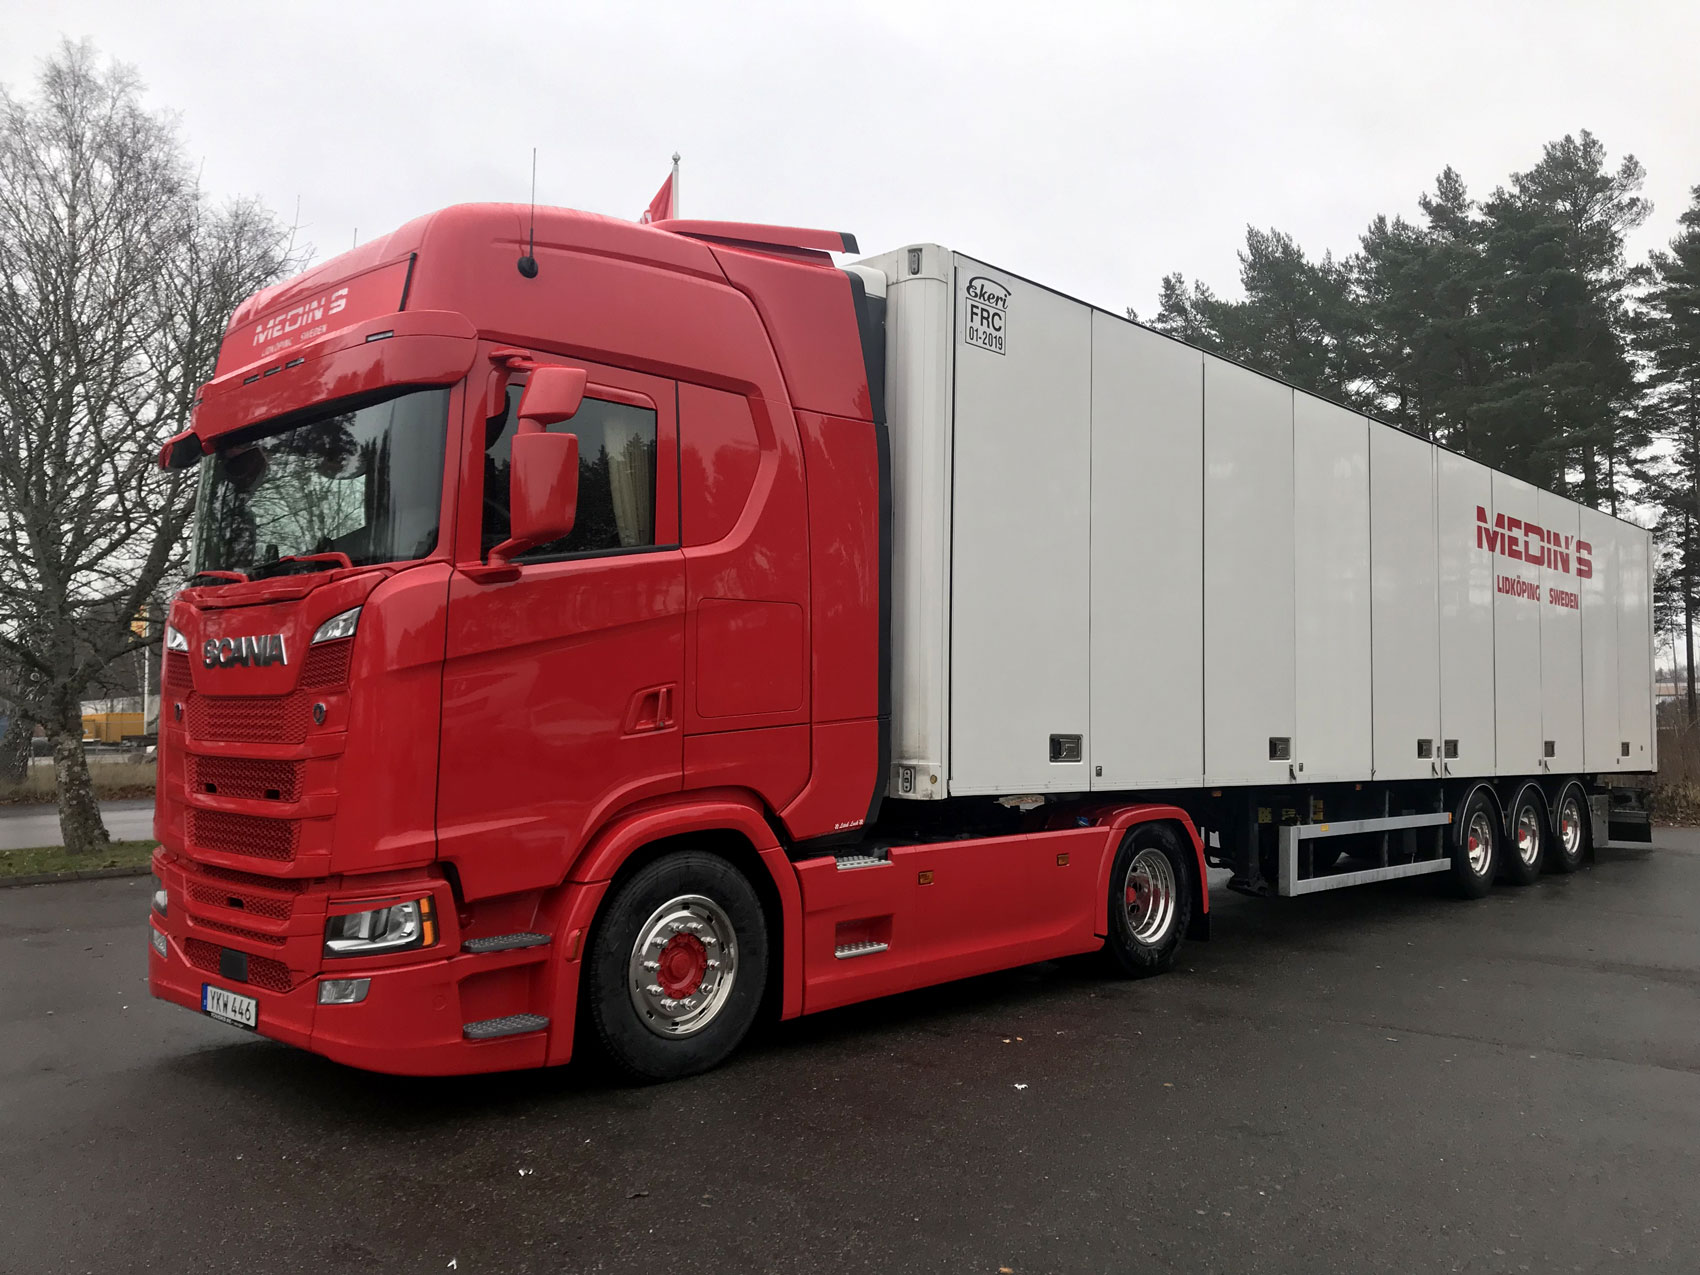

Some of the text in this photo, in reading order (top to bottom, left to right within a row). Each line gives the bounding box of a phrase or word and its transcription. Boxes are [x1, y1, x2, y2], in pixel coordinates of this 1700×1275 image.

[966, 276, 1011, 309] Ekeri
[252, 287, 348, 347] MEDIN'S
[970, 303, 1002, 332] FRC
[969, 325, 1003, 350] 01-2019
[1476, 505, 1593, 579] MEDIN'S
[1497, 574, 1579, 610] LIDKÖPING SWEDEN
[203, 633, 288, 669] SCANIA
[210, 989, 229, 1015] YKW
[231, 997, 251, 1021] 446
